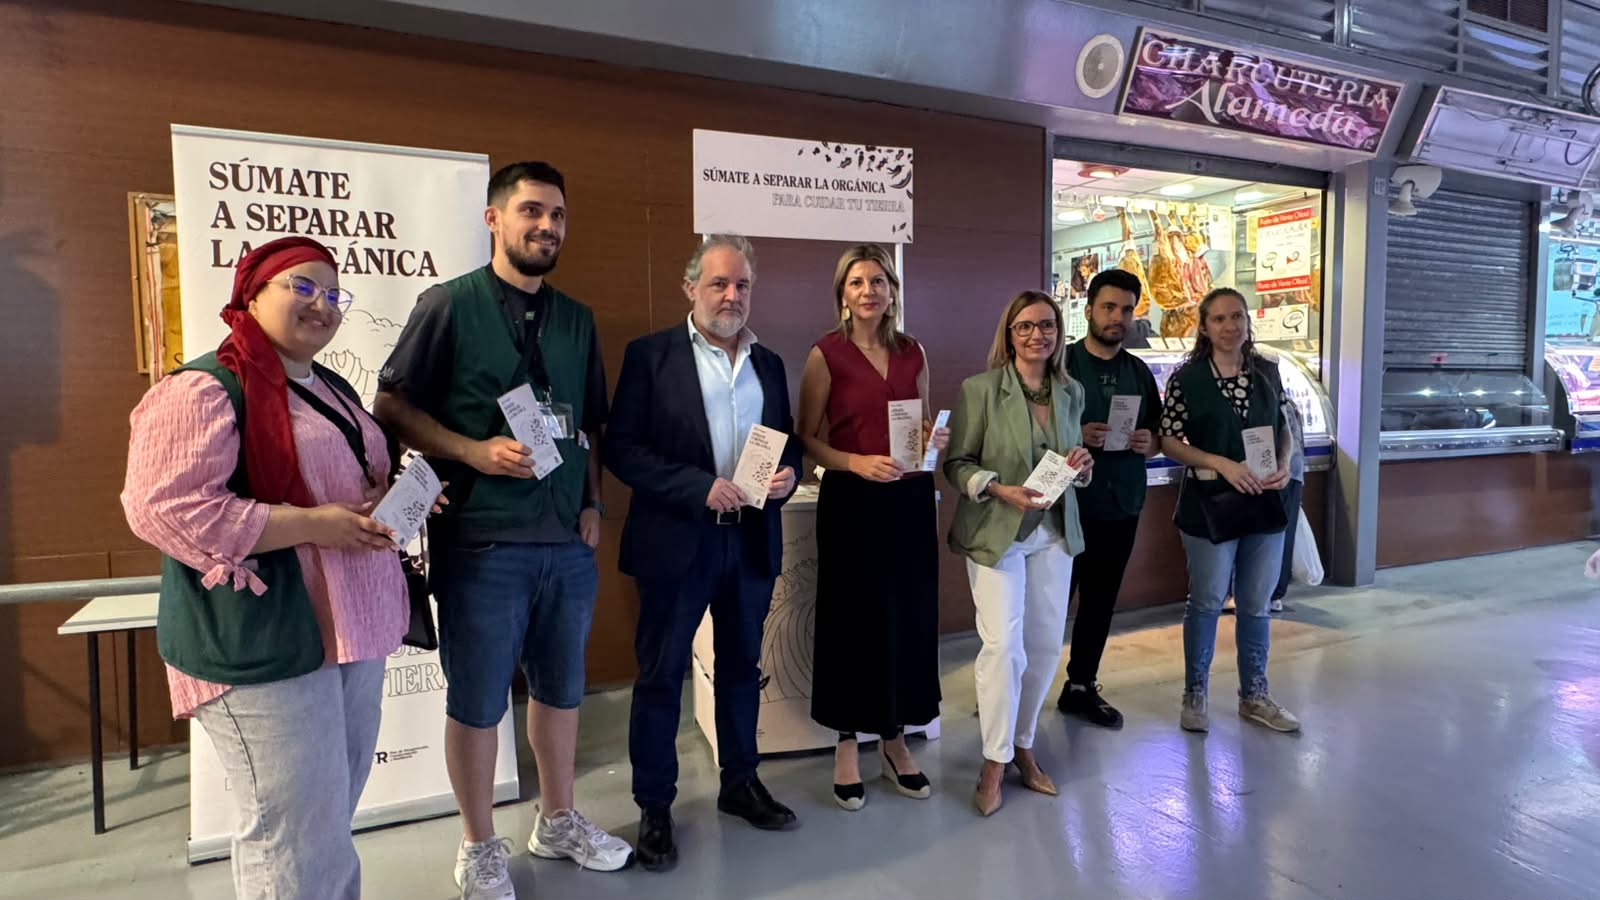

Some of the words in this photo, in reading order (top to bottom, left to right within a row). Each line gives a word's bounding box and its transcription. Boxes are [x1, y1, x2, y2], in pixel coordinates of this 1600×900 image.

[1142, 39, 1389, 108] CHARCUTERIA
[1165, 78, 1359, 136] Alameda
[209, 157, 351, 200] SÚMATE
[703, 166, 750, 184] SÚMATE
[752, 173, 761, 185] A
[763, 174, 812, 189] SEPARAR
[814, 178, 829, 190] LA
[832, 178, 886, 194] ORGÁNICA
[210, 200, 236, 229] A
[246, 203, 397, 239] SEPARAR
[772, 192, 802, 208] PARA
[803, 194, 846, 210] CUIDAR
[846, 199, 863, 210] TU
[864, 199, 905, 213] TIERRA
